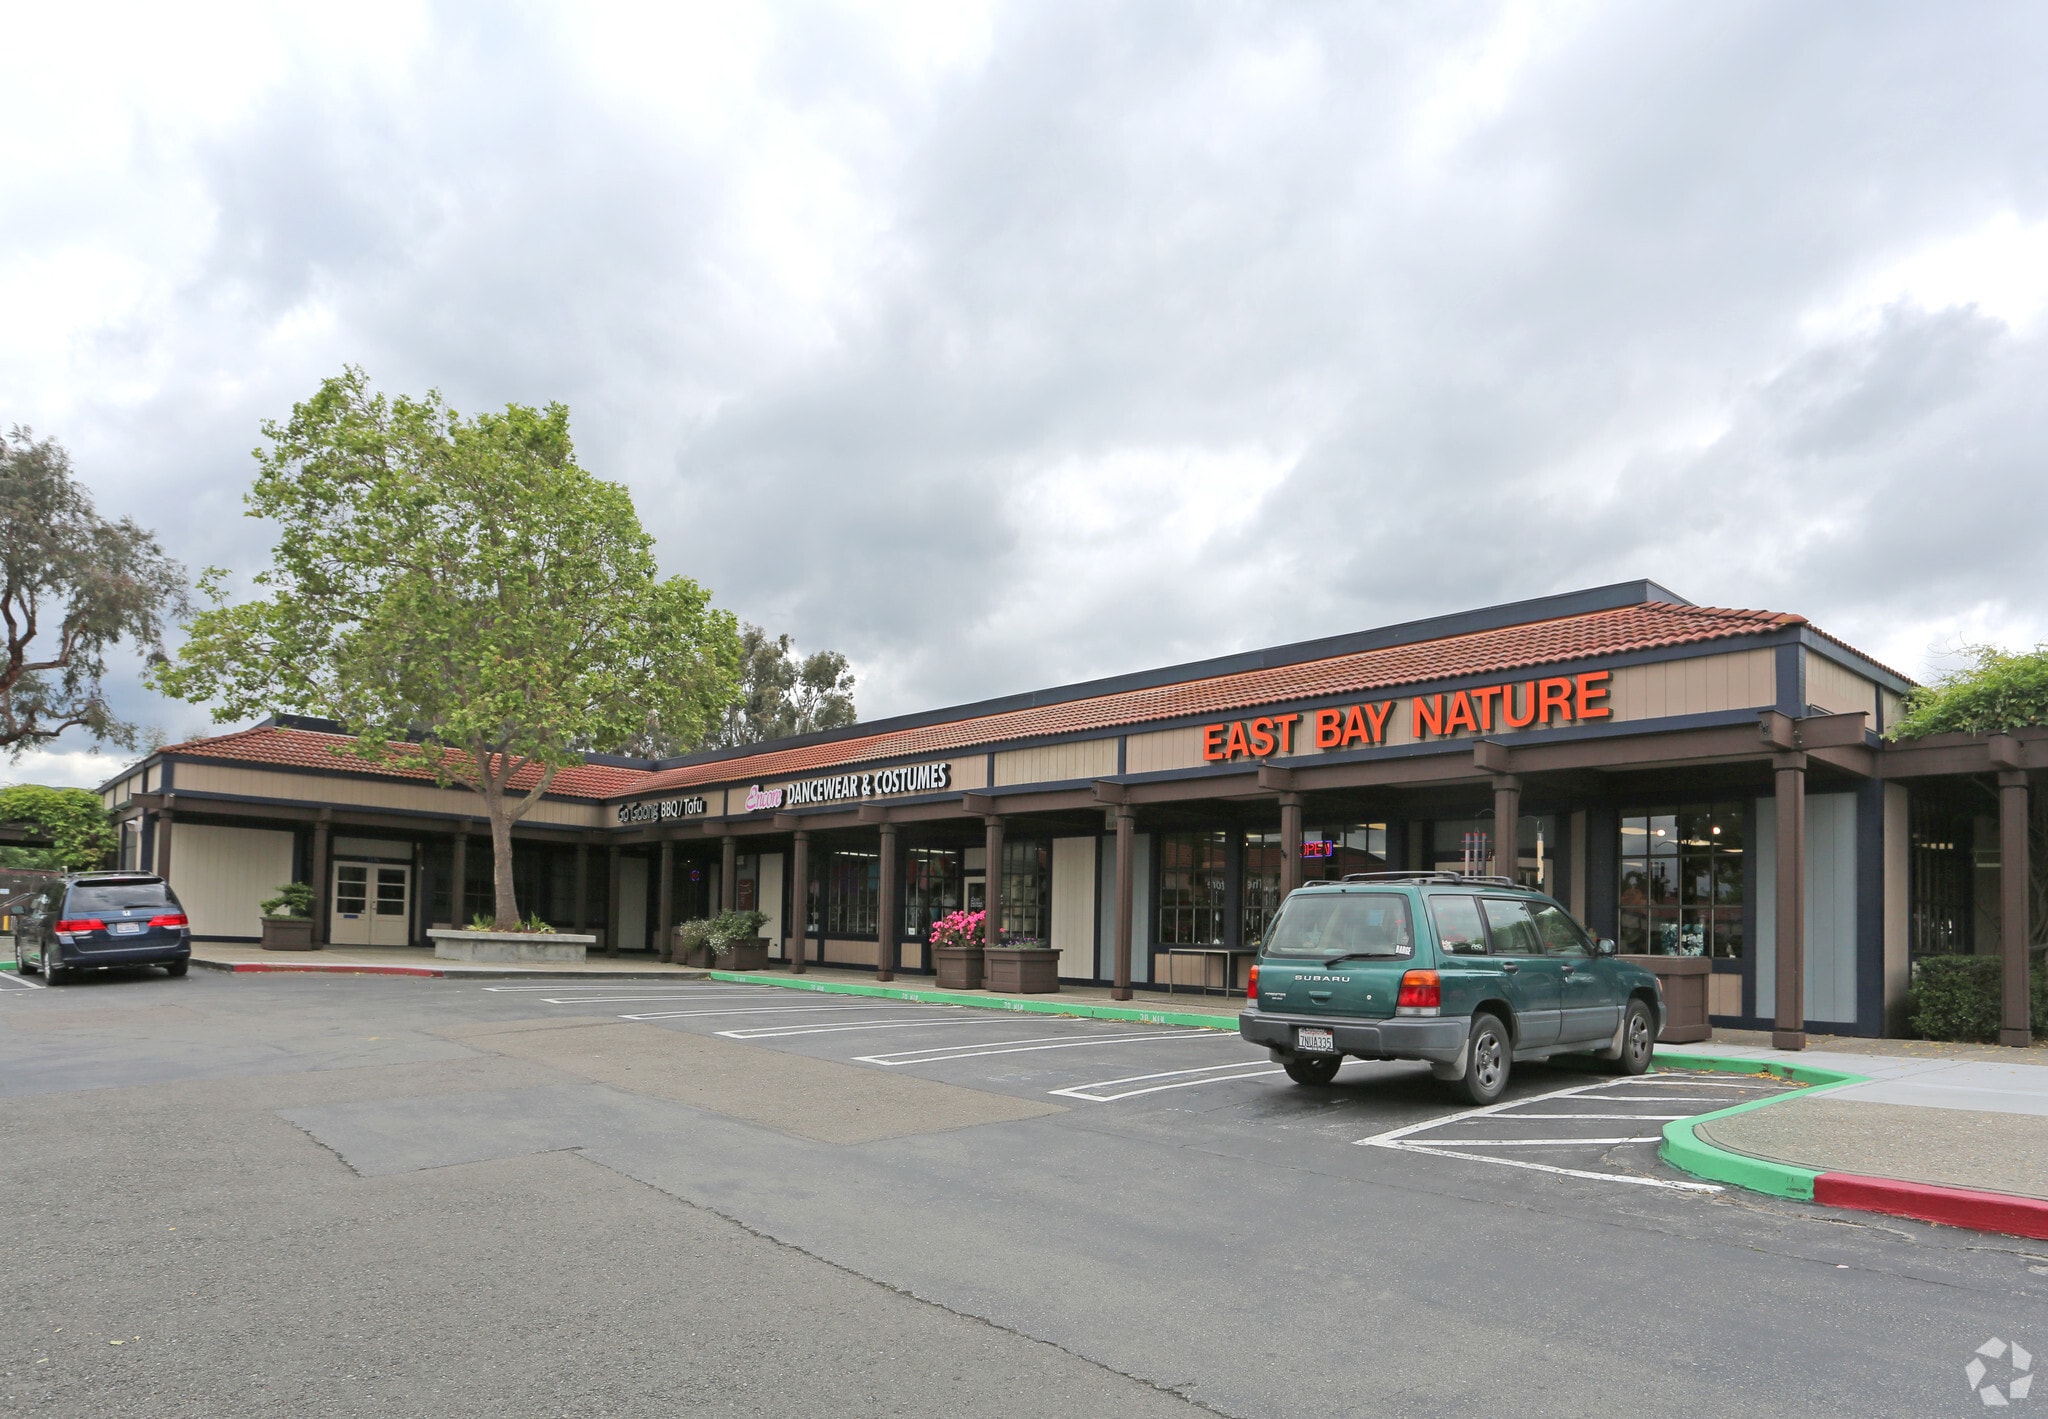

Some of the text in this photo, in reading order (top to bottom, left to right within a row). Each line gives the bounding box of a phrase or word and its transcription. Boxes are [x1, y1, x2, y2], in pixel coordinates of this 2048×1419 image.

[1203, 670, 1610, 761] EAST BAY NATURE
[744, 763, 947, 812] Encore DANCEWEAR & COSTUMES
[1295, 974, 1350, 983] SUBARU
